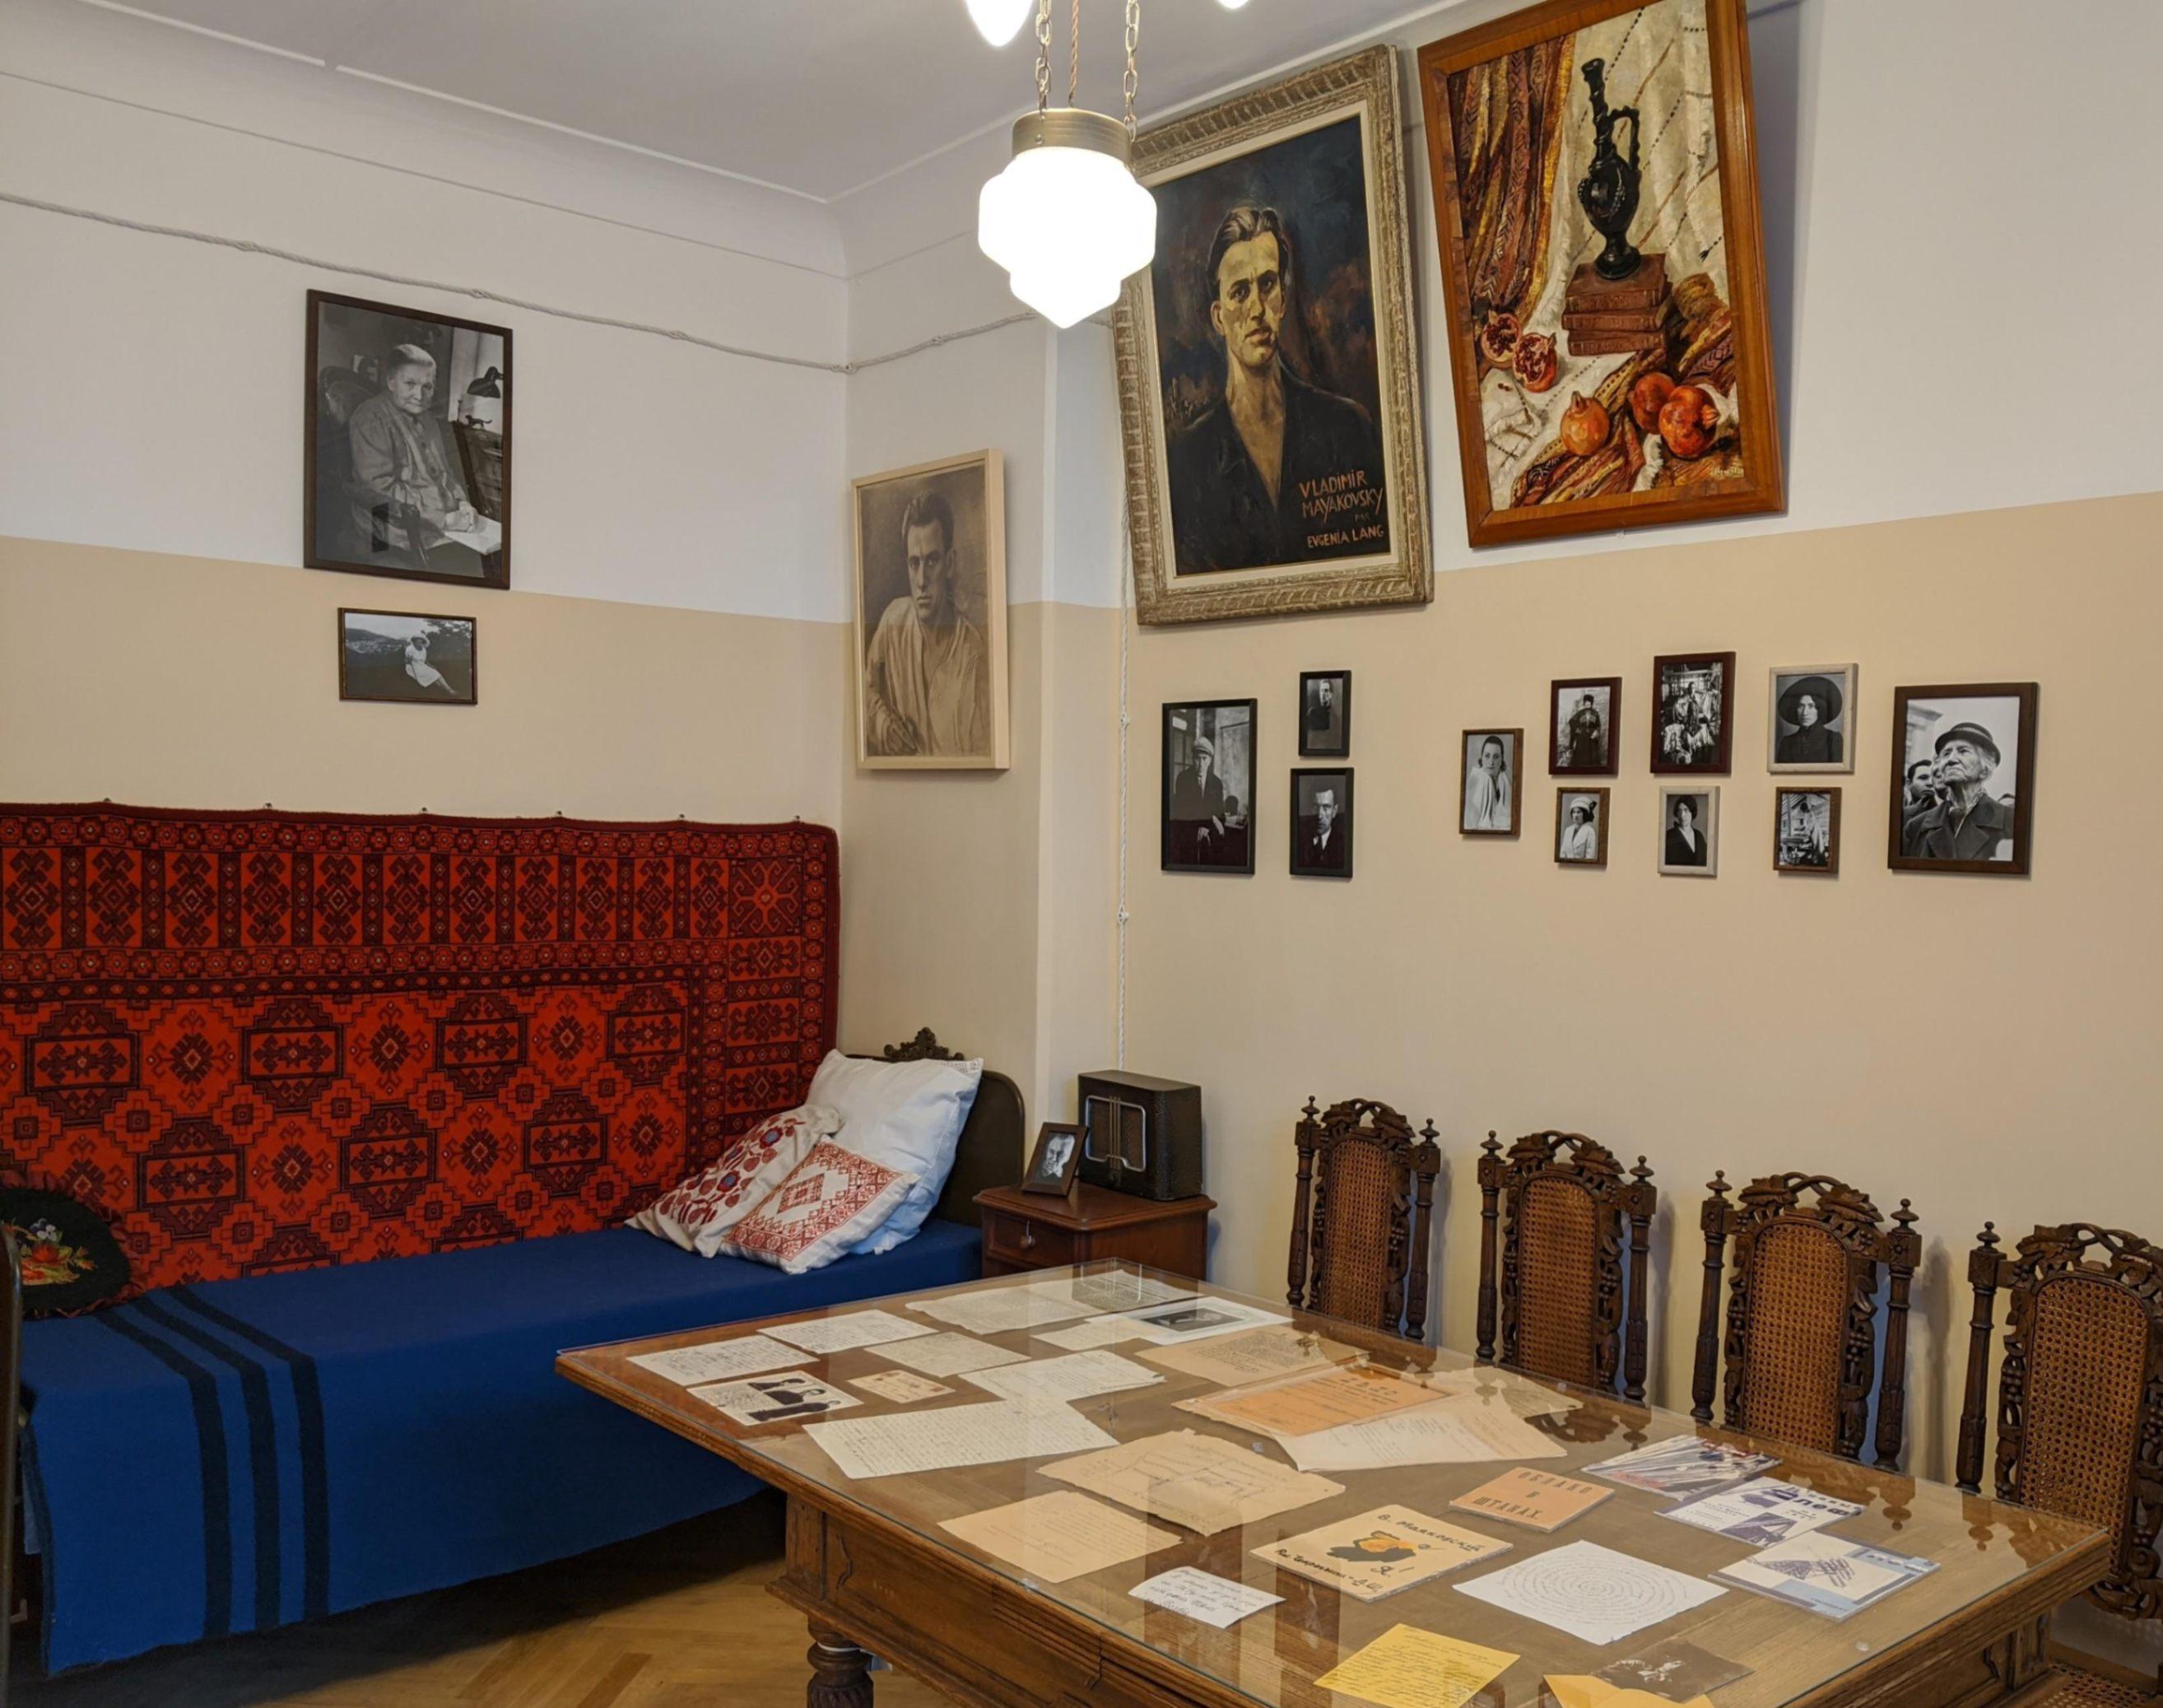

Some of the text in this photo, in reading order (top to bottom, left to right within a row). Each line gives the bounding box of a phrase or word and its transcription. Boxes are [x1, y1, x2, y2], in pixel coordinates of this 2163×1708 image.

[1300, 469, 1367, 498] VLADIMIR
[1302, 487, 1383, 524] MAYAKOVSKY
[1307, 529, 1350, 548] EVGENIA
